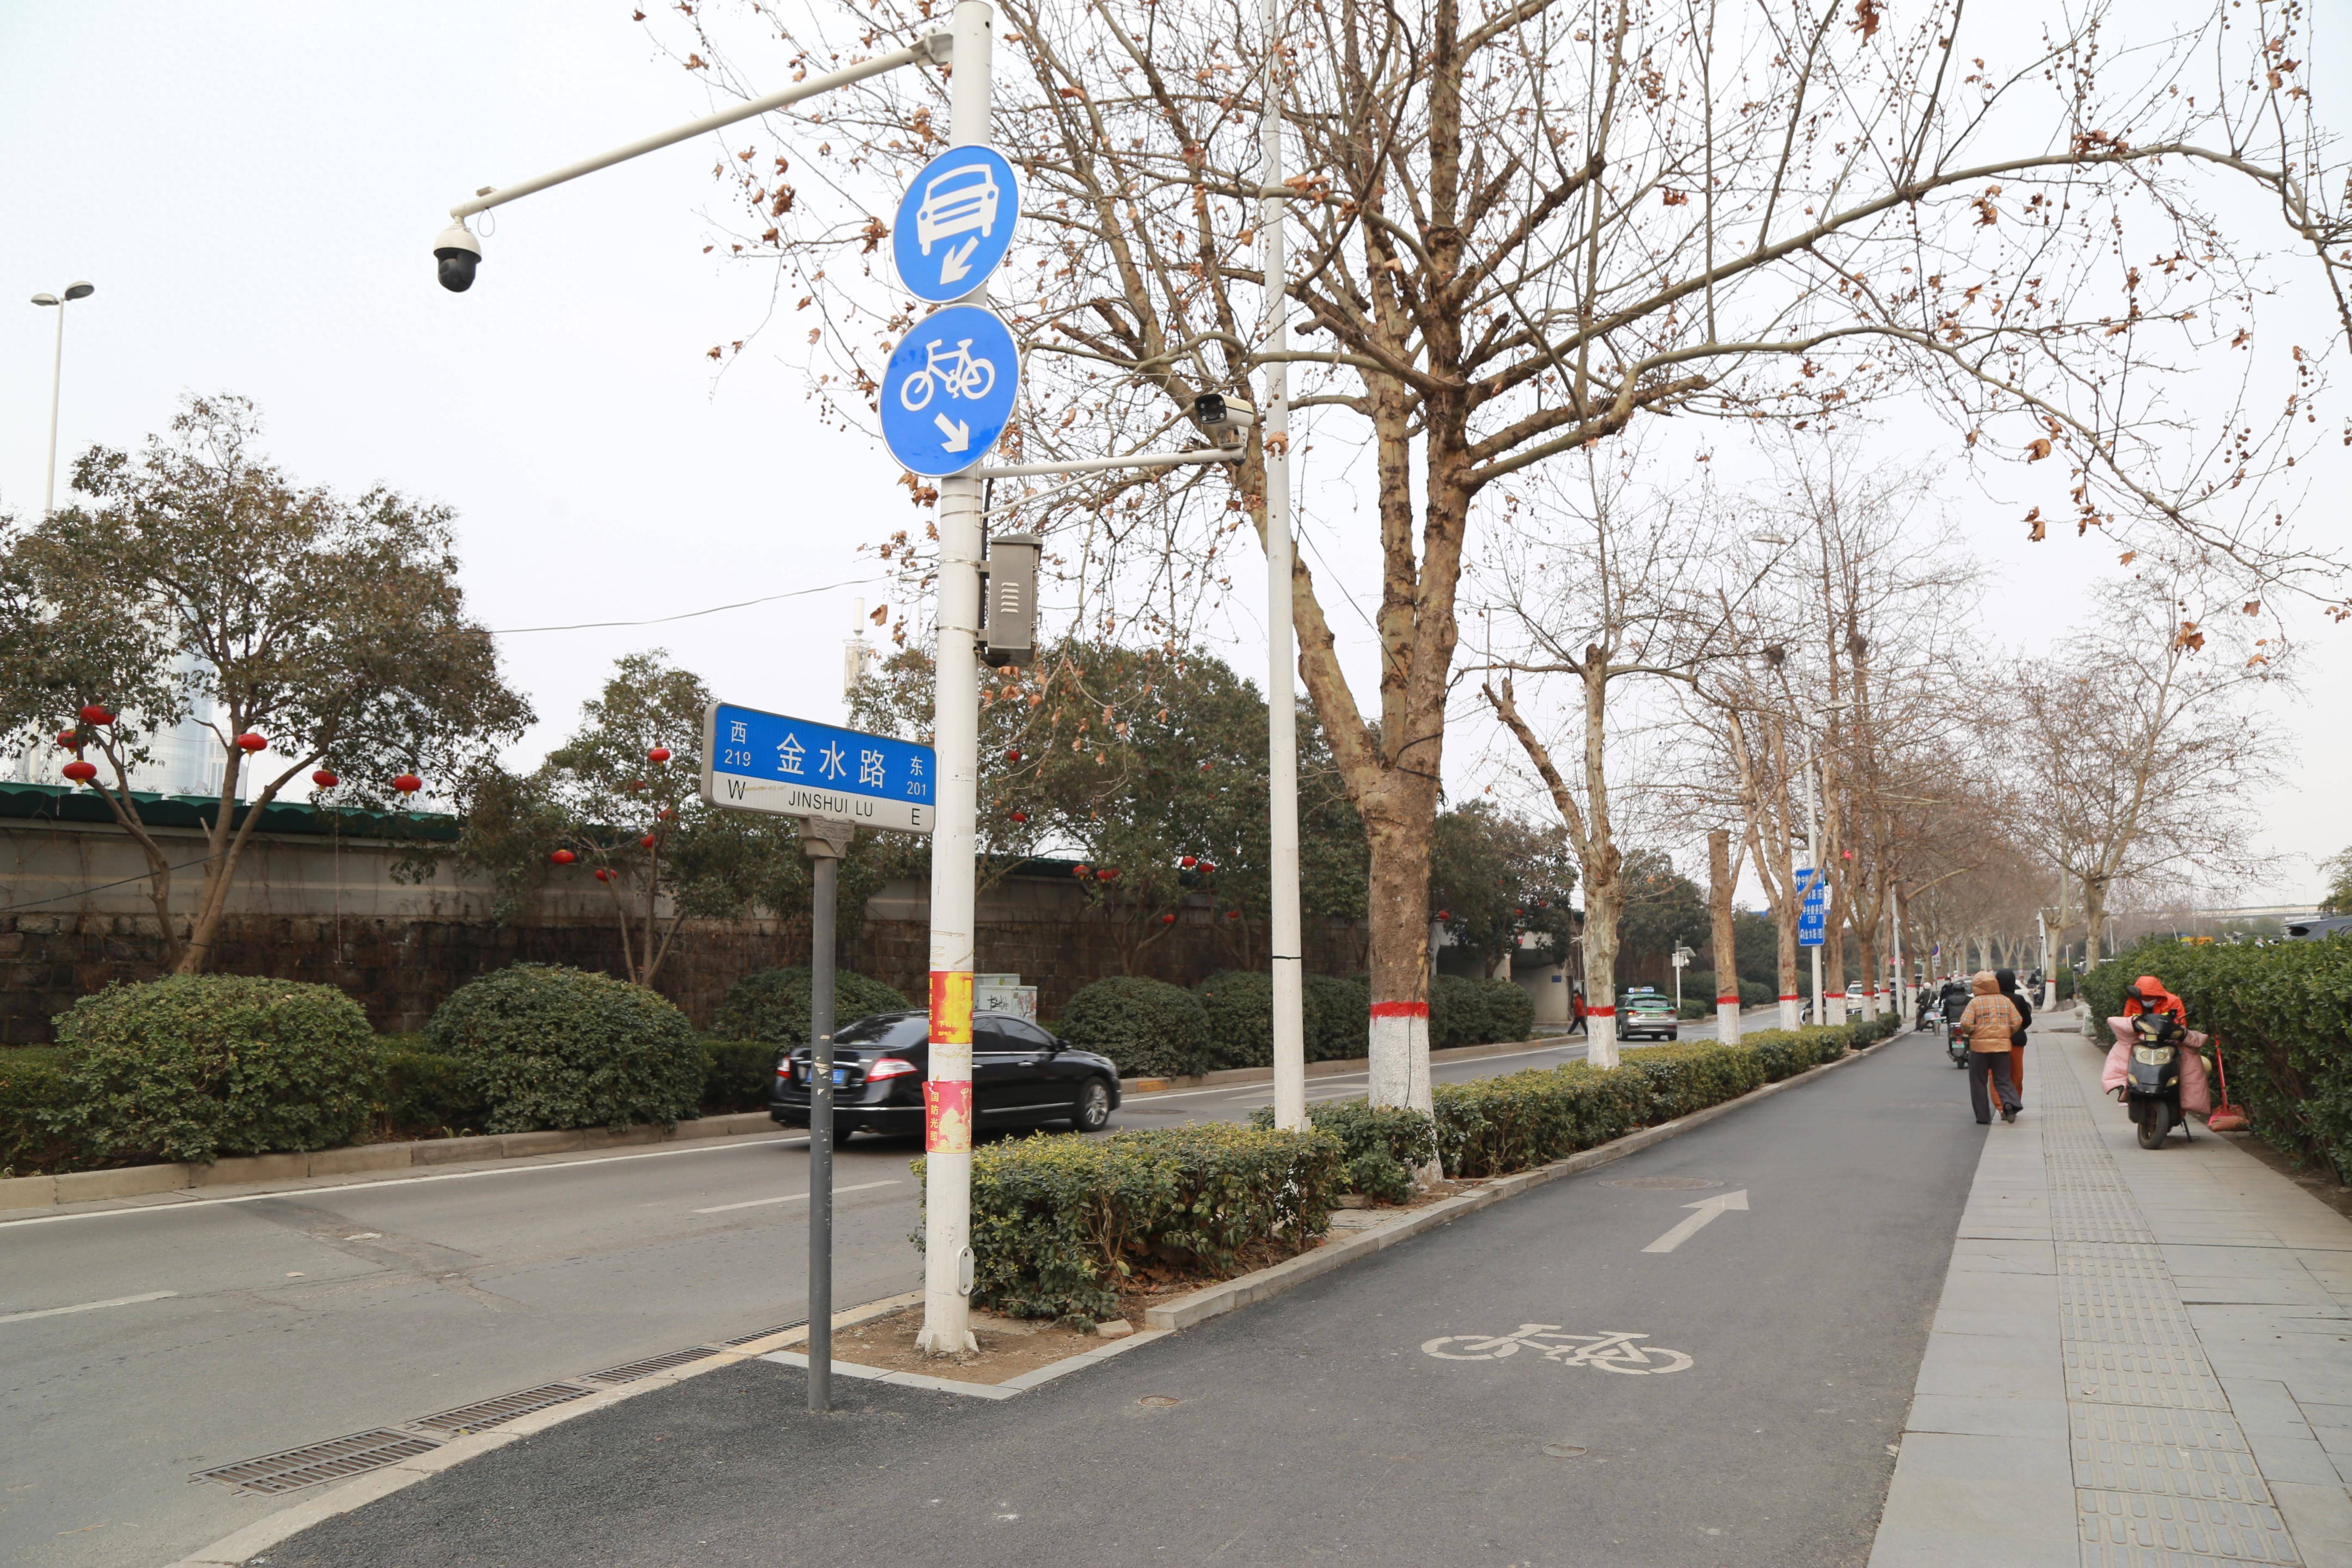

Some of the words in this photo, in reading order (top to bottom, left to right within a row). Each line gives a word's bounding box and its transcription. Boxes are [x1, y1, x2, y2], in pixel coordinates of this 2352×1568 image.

[731, 720, 747, 744] 西
[724, 749, 750, 766] 219
[776, 732, 886, 788] 金水路
[910, 756, 923, 776] 东
[728, 779, 746, 800] W
[907, 781, 926, 796] 201
[789, 791, 848, 813] JINSHUI
[856, 800, 873, 817] LU
[912, 808, 920, 825] E
[930, 1092, 939, 1142] 国防光缆
